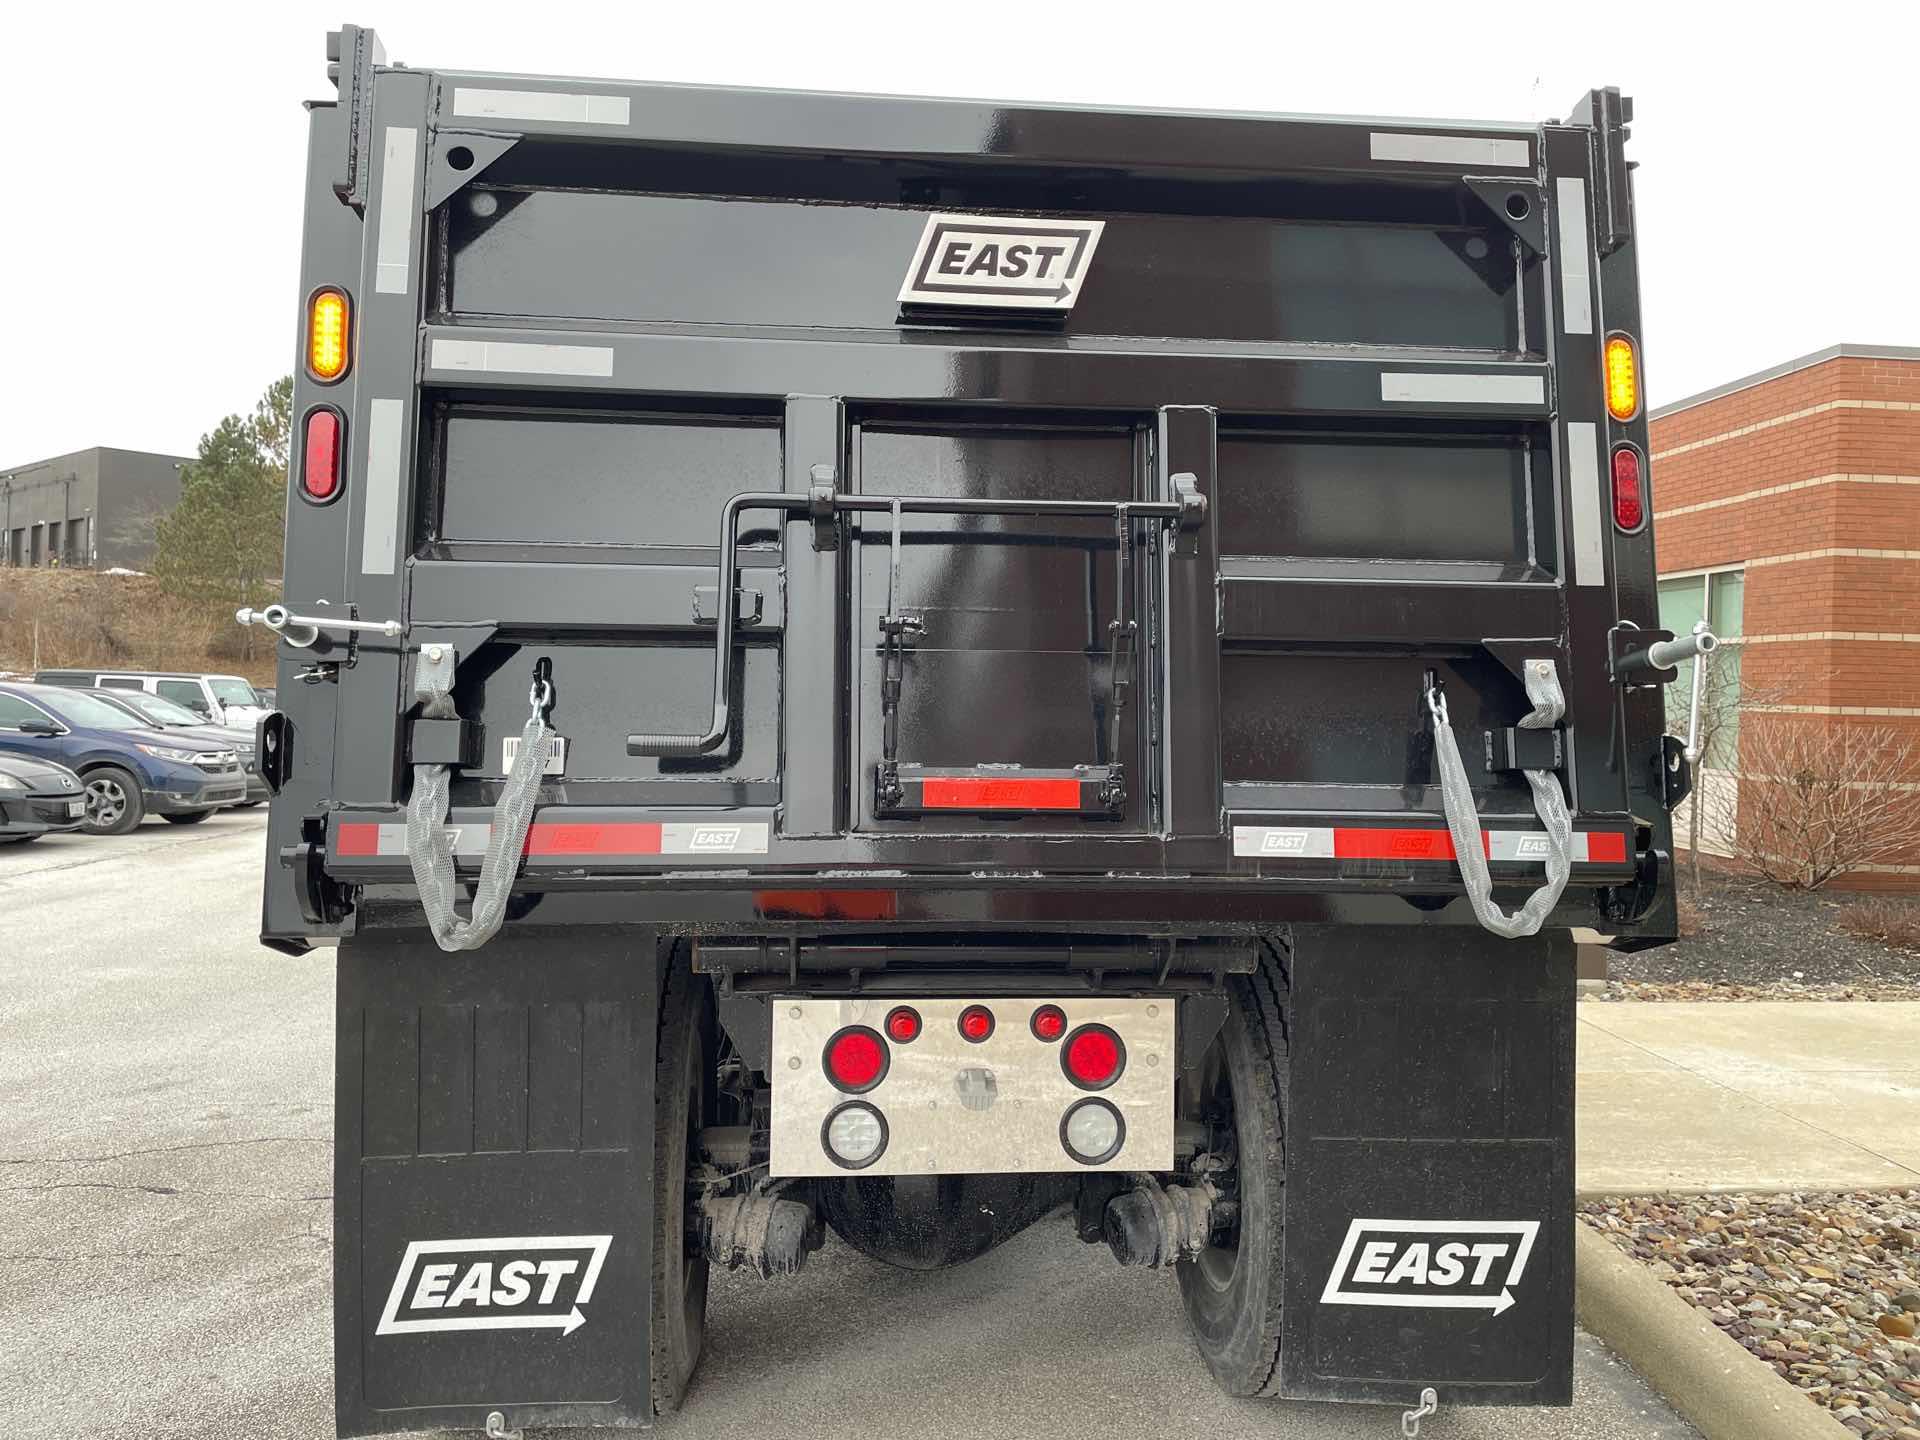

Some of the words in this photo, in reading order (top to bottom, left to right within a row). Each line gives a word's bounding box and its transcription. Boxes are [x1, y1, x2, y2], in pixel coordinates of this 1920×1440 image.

[938, 242, 1065, 279] EAST
[696, 832, 734, 845] EAST
[1267, 836, 1303, 849] EAST
[1352, 1242, 1509, 1285] EAST
[410, 1260, 579, 1309] EAST
